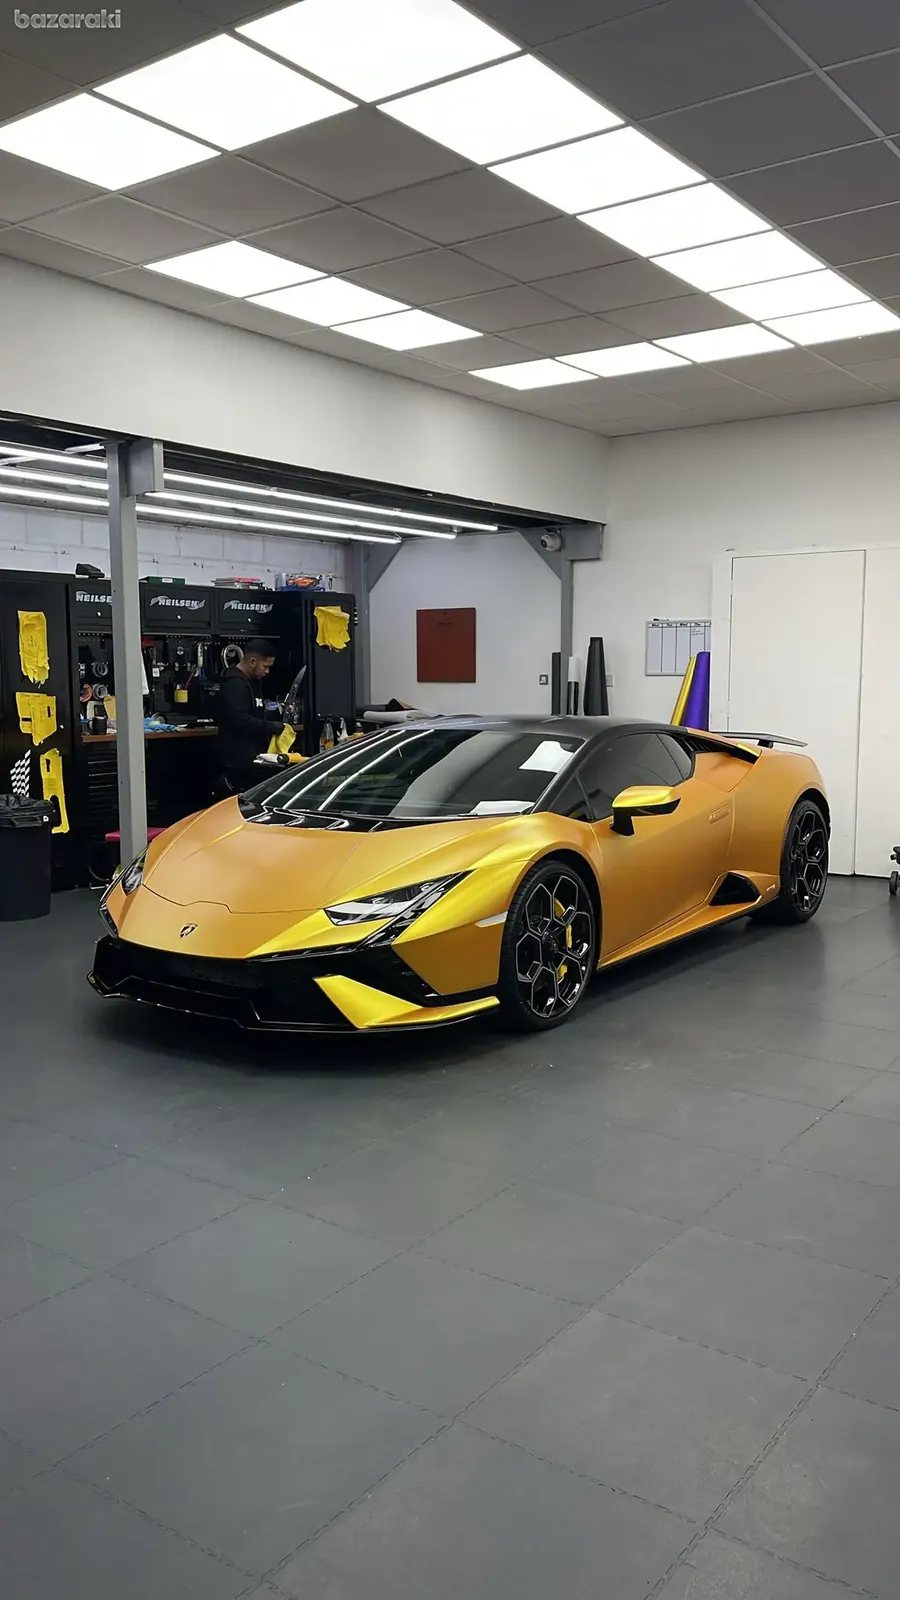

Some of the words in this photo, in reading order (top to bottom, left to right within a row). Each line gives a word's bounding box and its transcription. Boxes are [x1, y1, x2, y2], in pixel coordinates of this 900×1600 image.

[75, 593, 112, 603] NEILSE
[158, 599, 198, 608] NEILSEN
[230, 603, 267, 611] NEILSEN
